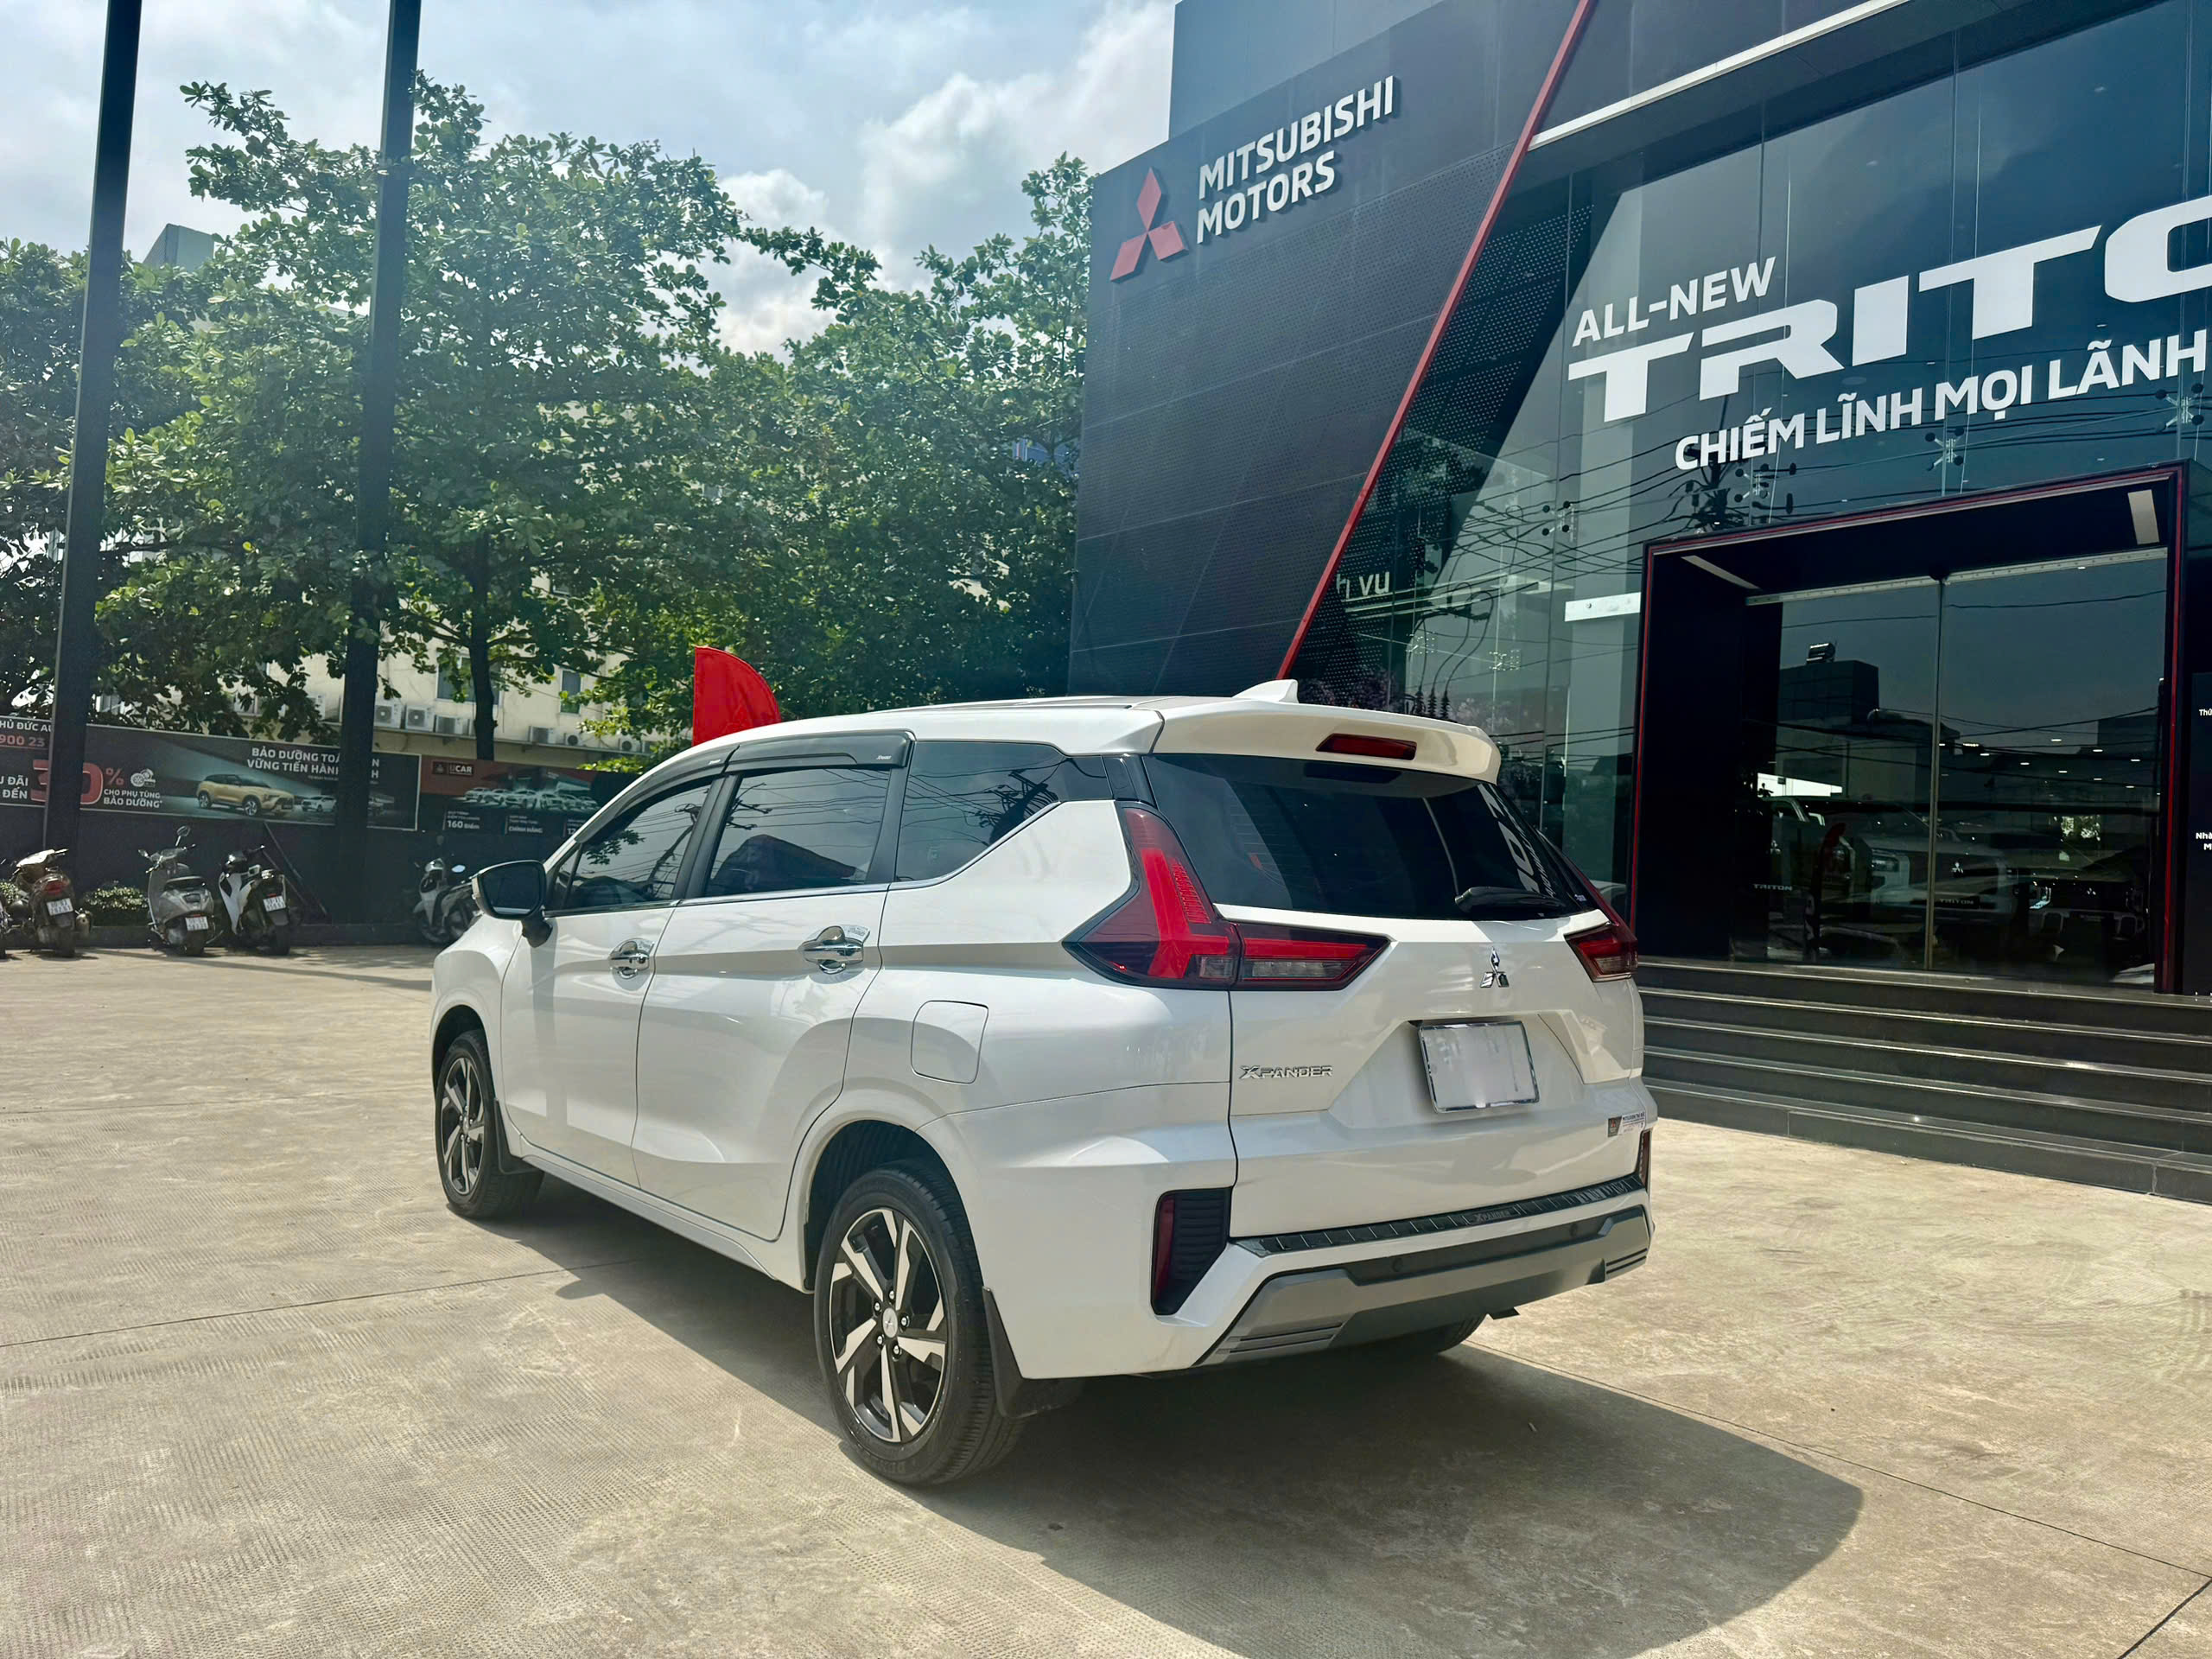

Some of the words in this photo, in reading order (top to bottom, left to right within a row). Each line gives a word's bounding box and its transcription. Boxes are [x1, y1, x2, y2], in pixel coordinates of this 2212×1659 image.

[1198, 75, 1394, 200] MITSUBISHI
[1197, 150, 1335, 245] MOTORS
[1573, 257, 1776, 346] ALL-NEW
[1675, 407, 1805, 471] CHIẾM
[1815, 391, 1923, 445] LĨNH
[1935, 365, 2031, 421] MỌI
[2048, 329, 2208, 400] LÃNH
[17, 721, 39, 731] ĐỨC
[251, 746, 276, 759] BẢO
[278, 749, 318, 762] DƯỠNG
[246, 759, 279, 771] VỮNG
[282, 760, 308, 772] TIẾN
[7, 775, 29, 786] ĐÃI
[2, 786, 28, 799] ĐẾN
[104, 796, 124, 805] BẢO
[448, 820, 463, 829] 160
[1239, 1065, 1332, 1079] XPANDER
